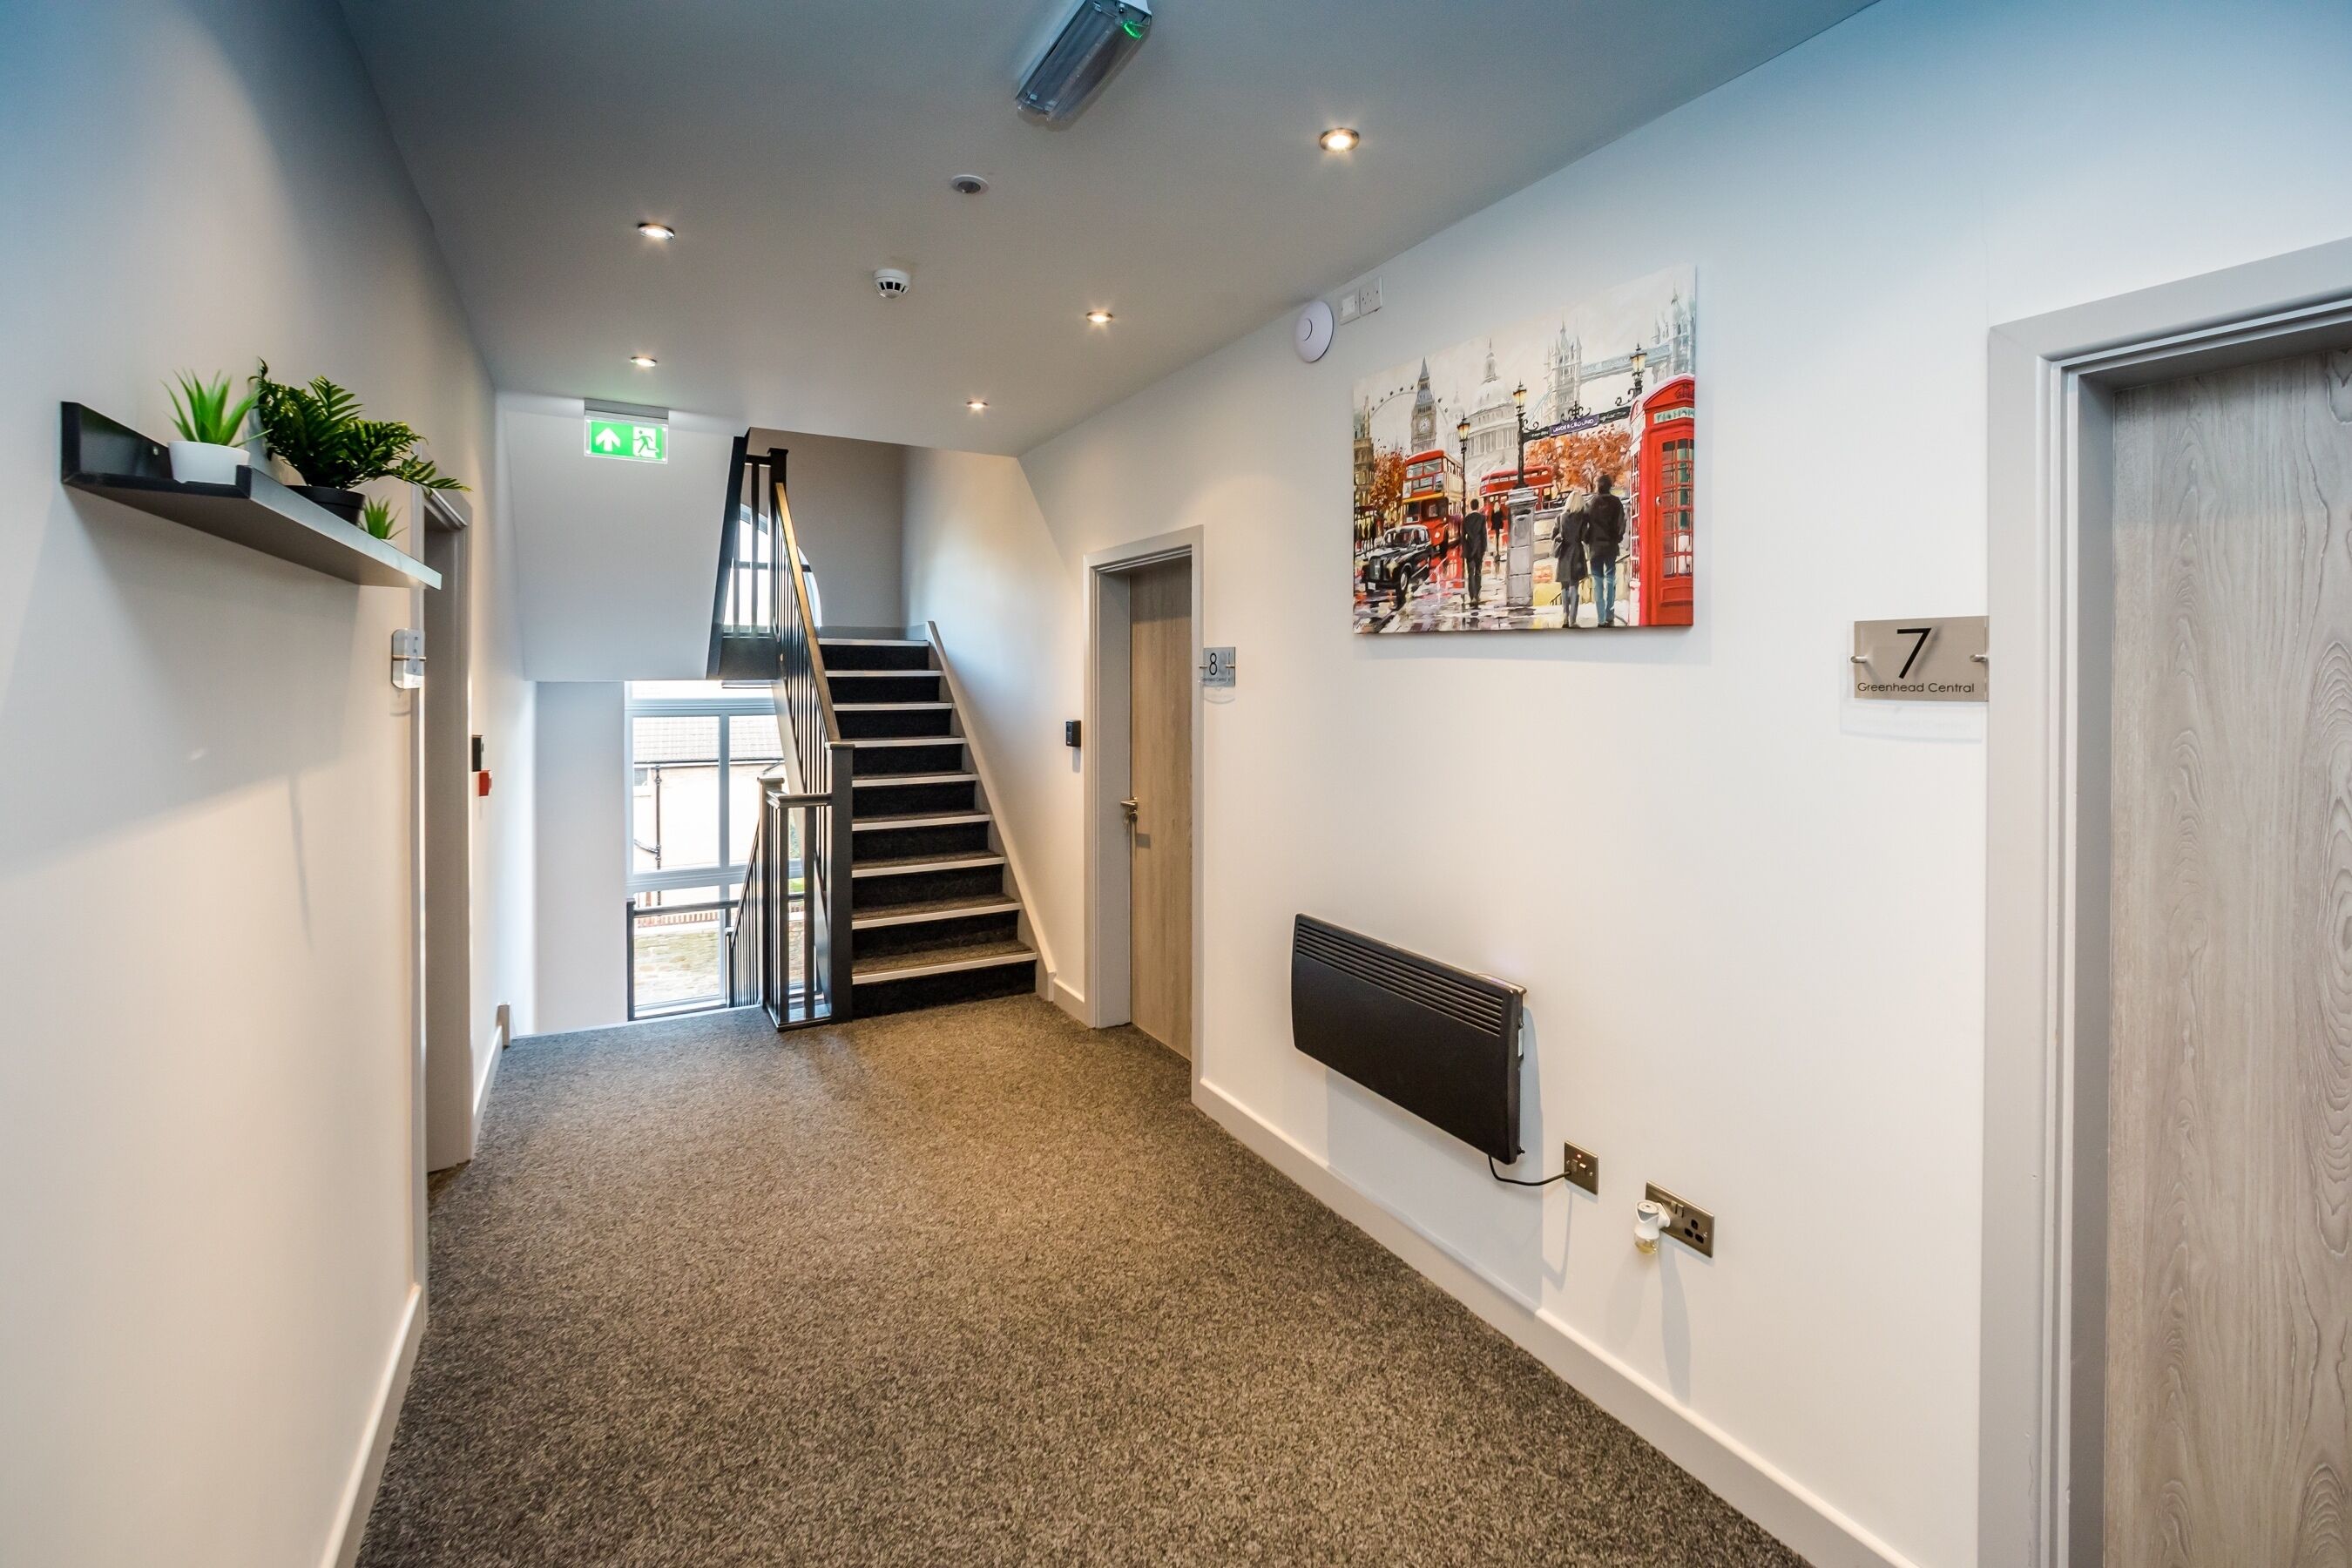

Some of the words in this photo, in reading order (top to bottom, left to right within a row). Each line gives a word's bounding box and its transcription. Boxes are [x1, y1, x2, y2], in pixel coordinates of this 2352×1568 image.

[1209, 652, 1218, 676] 8
[1896, 627, 1932, 679] 7
[1857, 682, 1924, 693] Greenhead
[1928, 682, 1975, 693] Central
